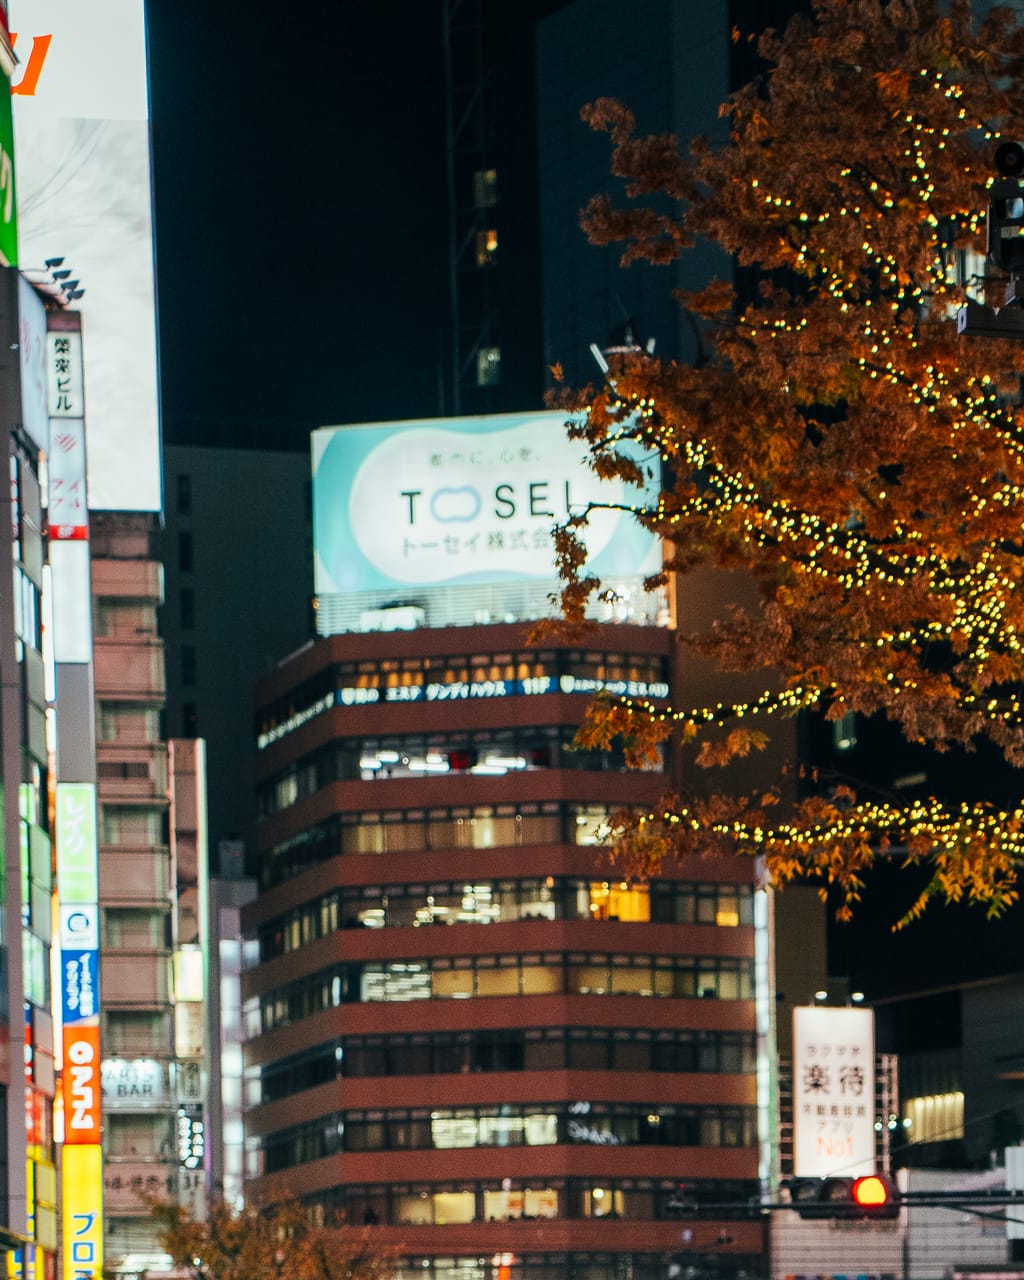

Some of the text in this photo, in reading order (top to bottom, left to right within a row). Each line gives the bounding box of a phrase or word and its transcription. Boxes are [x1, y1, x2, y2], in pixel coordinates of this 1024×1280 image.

[401, 480, 571, 524] TOSEI
[403, 533, 554, 557] トーセイ株式会
